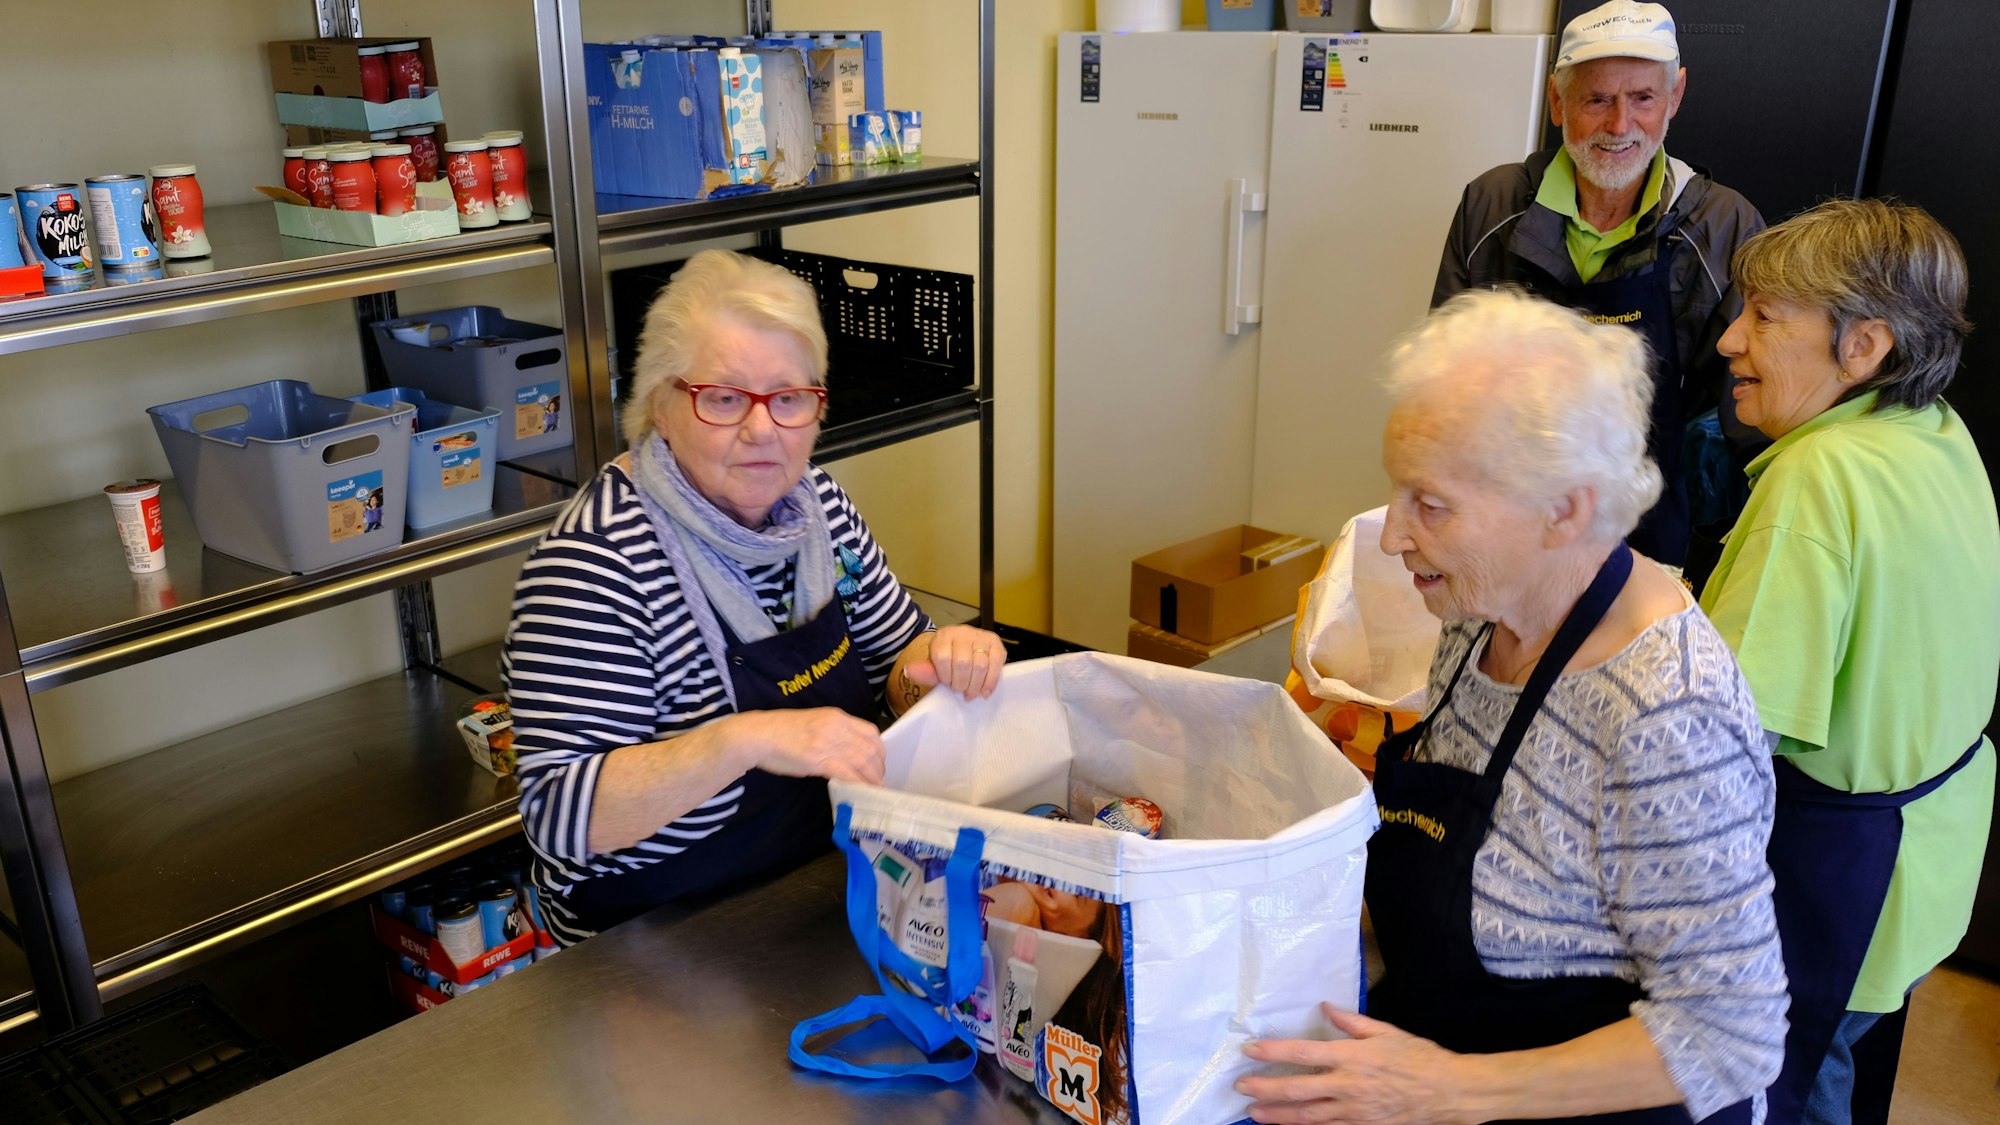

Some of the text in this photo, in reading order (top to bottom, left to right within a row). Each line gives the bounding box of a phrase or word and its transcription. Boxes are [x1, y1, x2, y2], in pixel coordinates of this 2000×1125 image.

[1681, 24, 1744, 34] LIEBHERR
[612, 105, 650, 116] FETTARME
[1137, 112, 1179, 121] LIEBHERR
[611, 114, 655, 130] H-MILCH
[1369, 123, 1419, 133] LIEBHERR
[448, 161, 476, 186] Samt
[152, 186, 182, 213] Samt
[41, 208, 86, 241] KOKOS
[776, 668, 813, 697] Tafel
[909, 919, 945, 938] AVEO
[400, 934, 431, 961] REWE
[905, 930, 945, 951] INTENSIV
[482, 947, 512, 969] REWE
[961, 1019, 981, 1034] AVEO
[1005, 1042, 1031, 1059] AVEO
[1047, 1024, 1101, 1058] Müller
[1059, 1067, 1087, 1104] M
